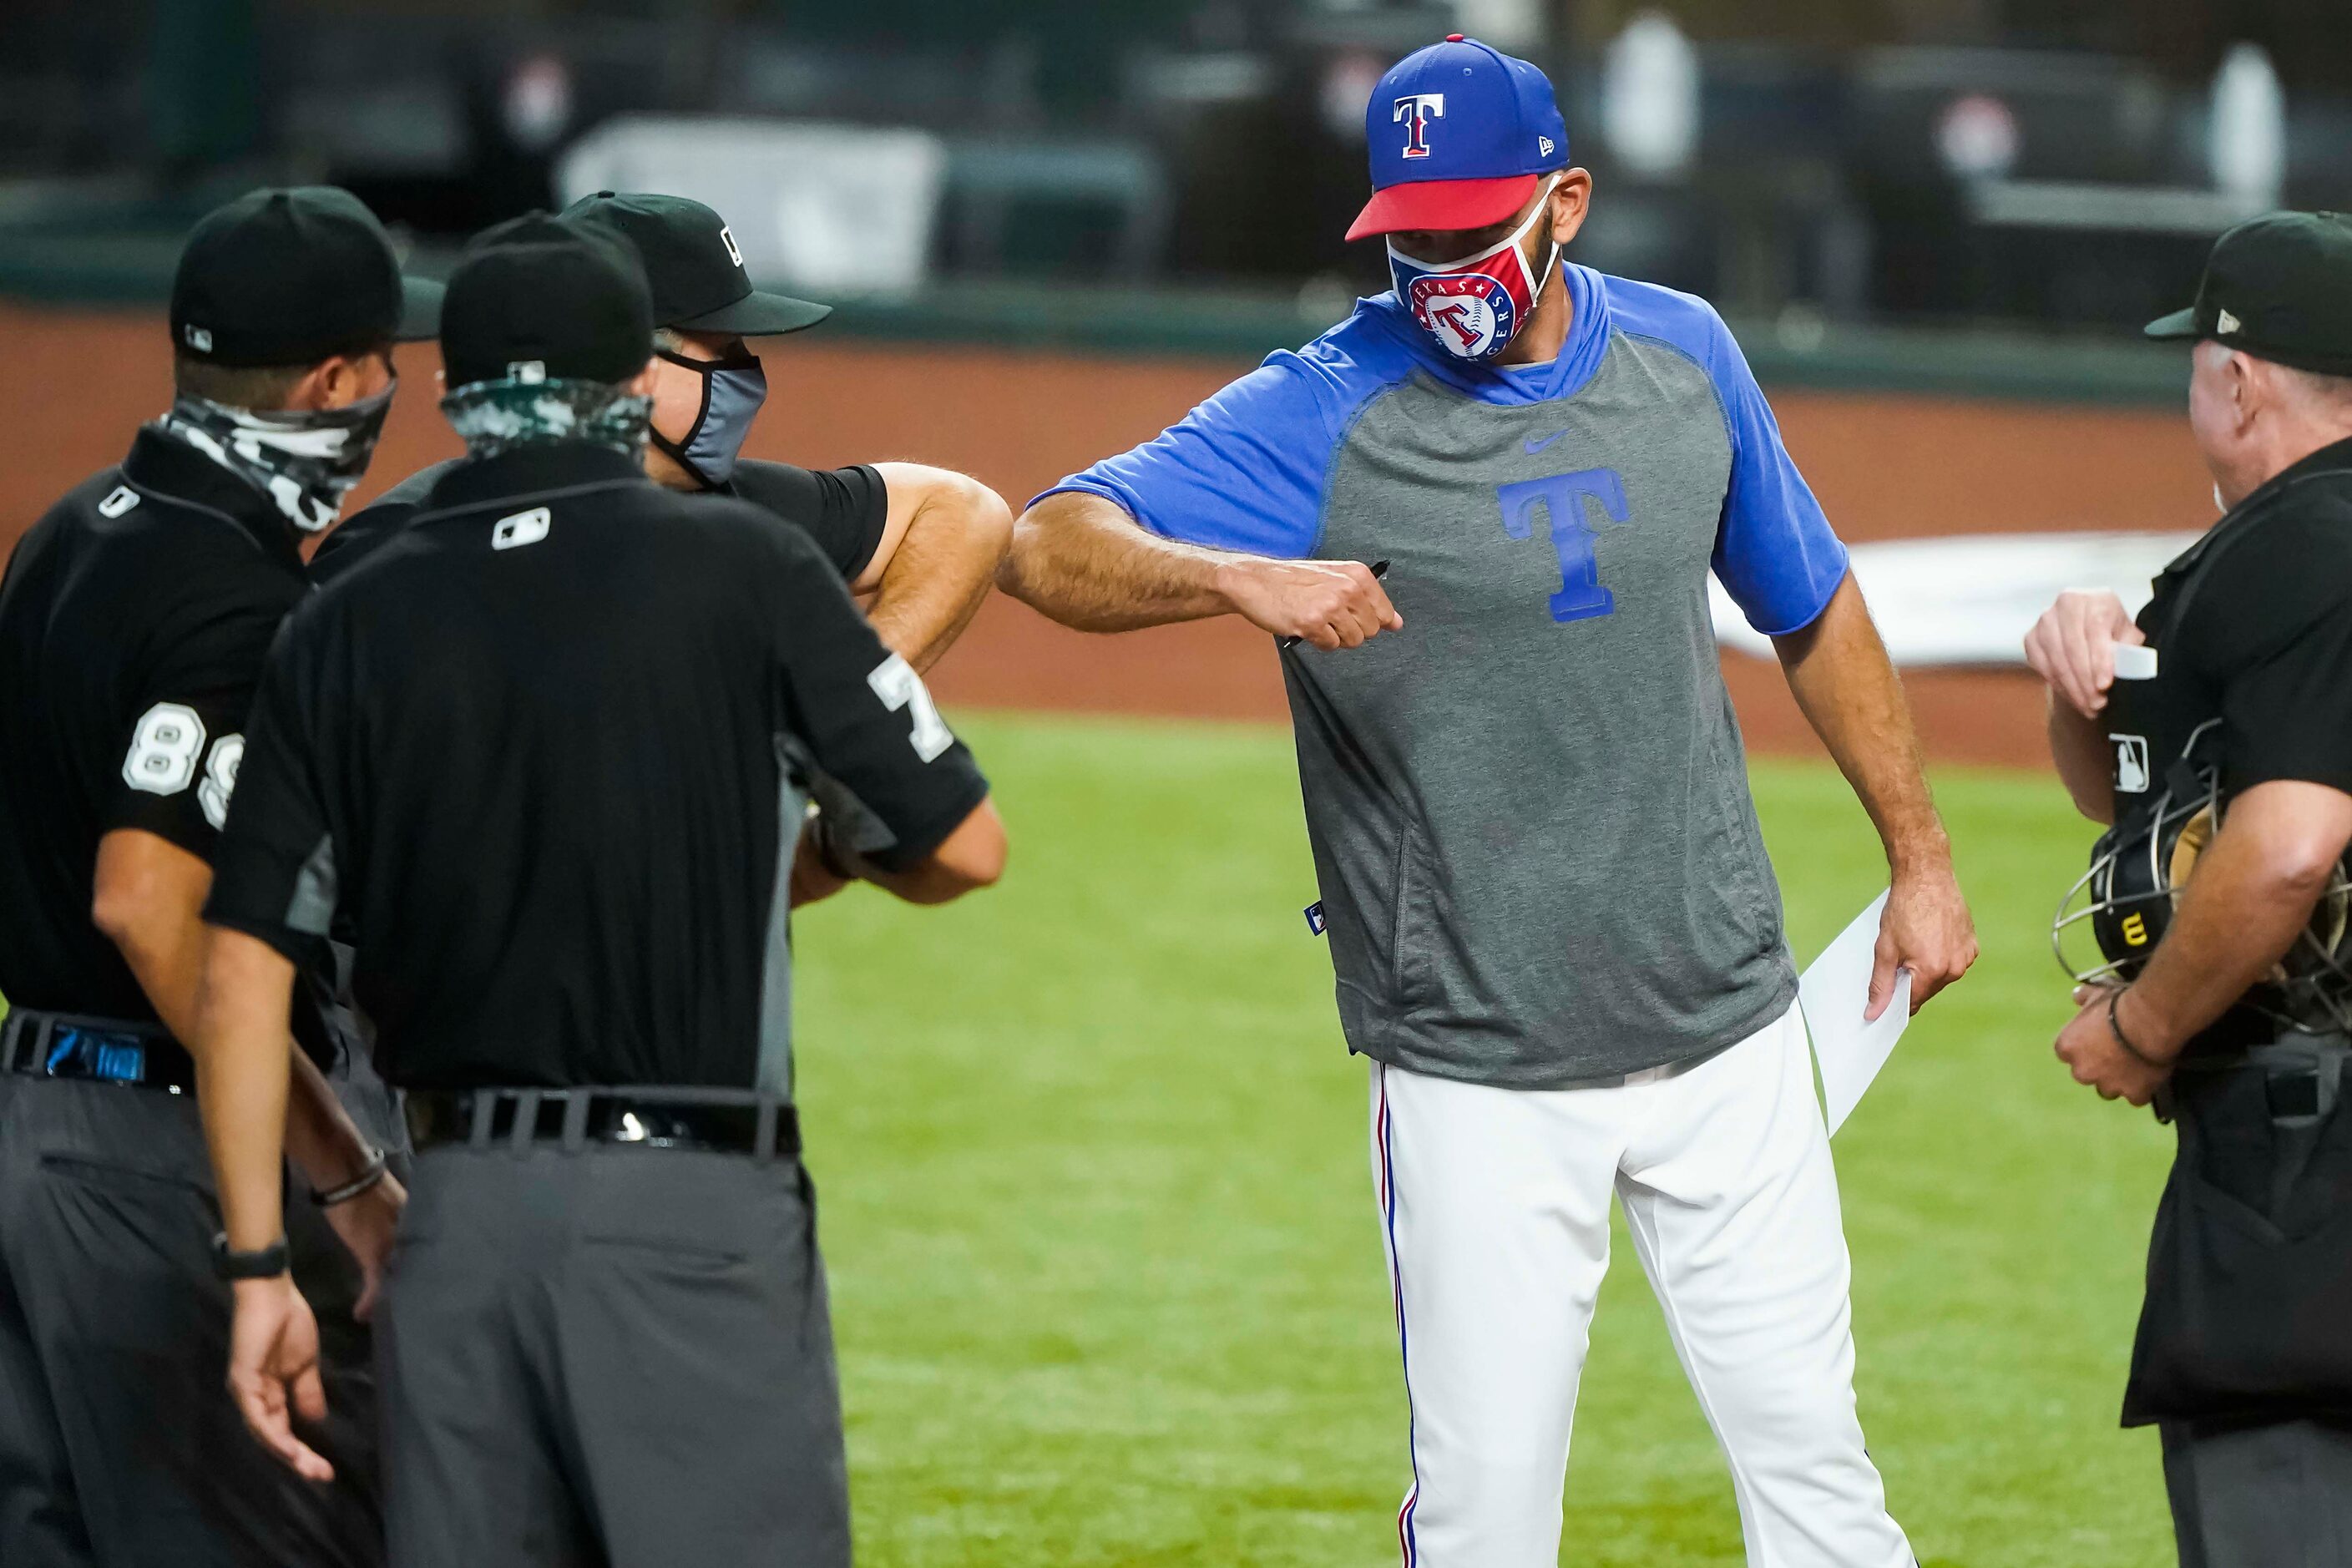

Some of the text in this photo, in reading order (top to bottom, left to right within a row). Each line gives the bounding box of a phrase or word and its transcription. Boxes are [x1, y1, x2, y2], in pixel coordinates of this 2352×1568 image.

[1393, 93, 1445, 159] T
[1415, 281, 1467, 308] TEXAS
[1432, 303, 1485, 347] T
[1497, 468, 1630, 623] T
[867, 650, 954, 763] 7
